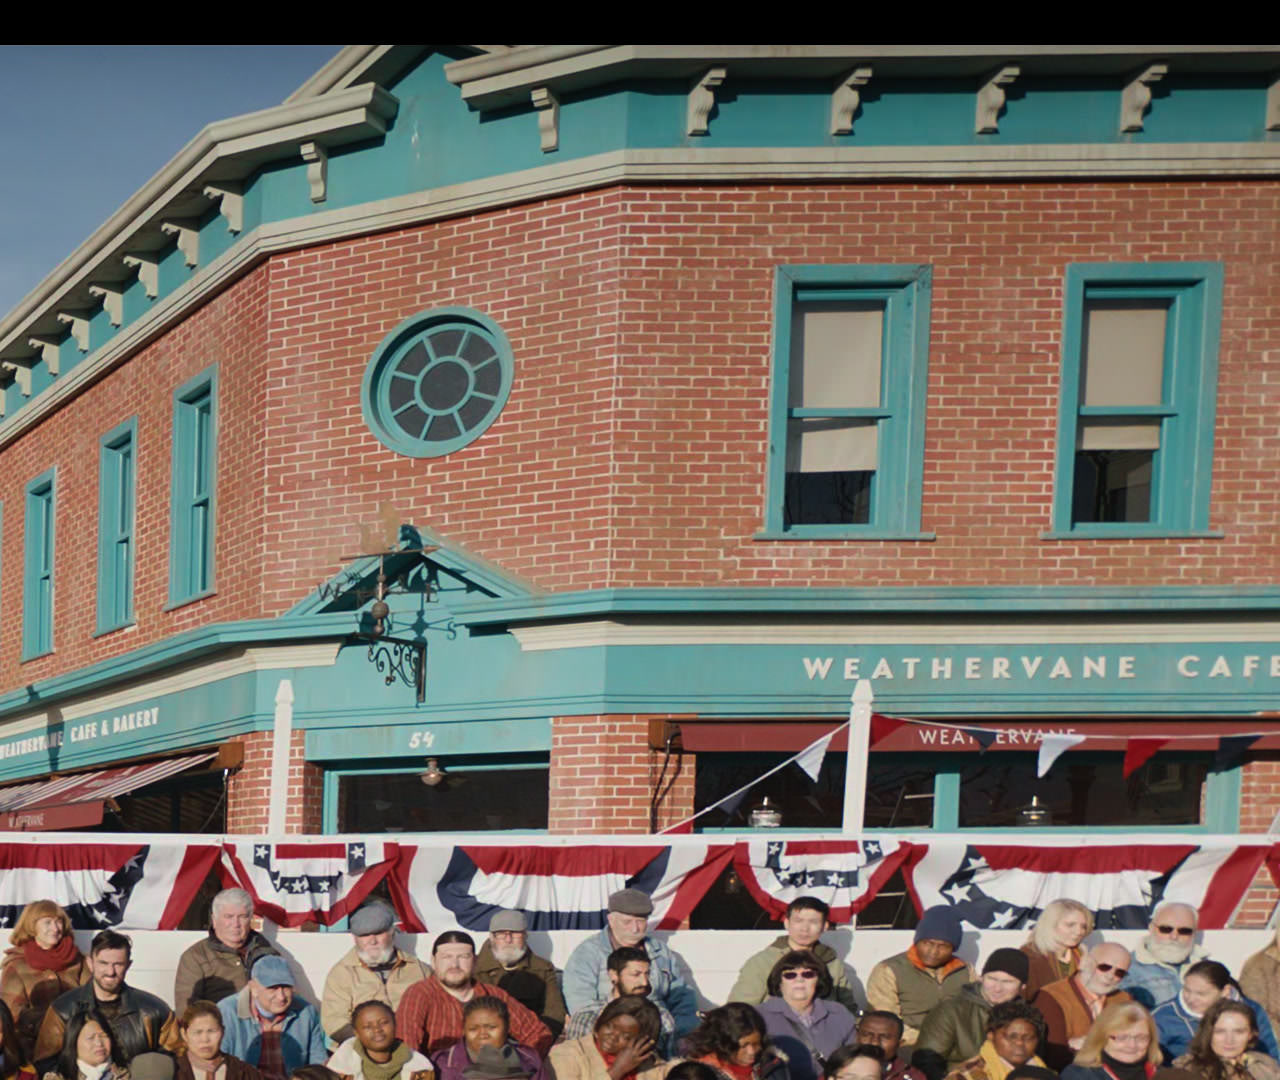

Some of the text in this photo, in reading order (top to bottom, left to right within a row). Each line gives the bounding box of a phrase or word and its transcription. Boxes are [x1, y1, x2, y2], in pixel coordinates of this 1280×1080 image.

[803, 655, 1280, 681] WEATHERVANE CAFE
[70, 722, 98, 743] CAFE
[112, 706, 160, 734] BAKERY
